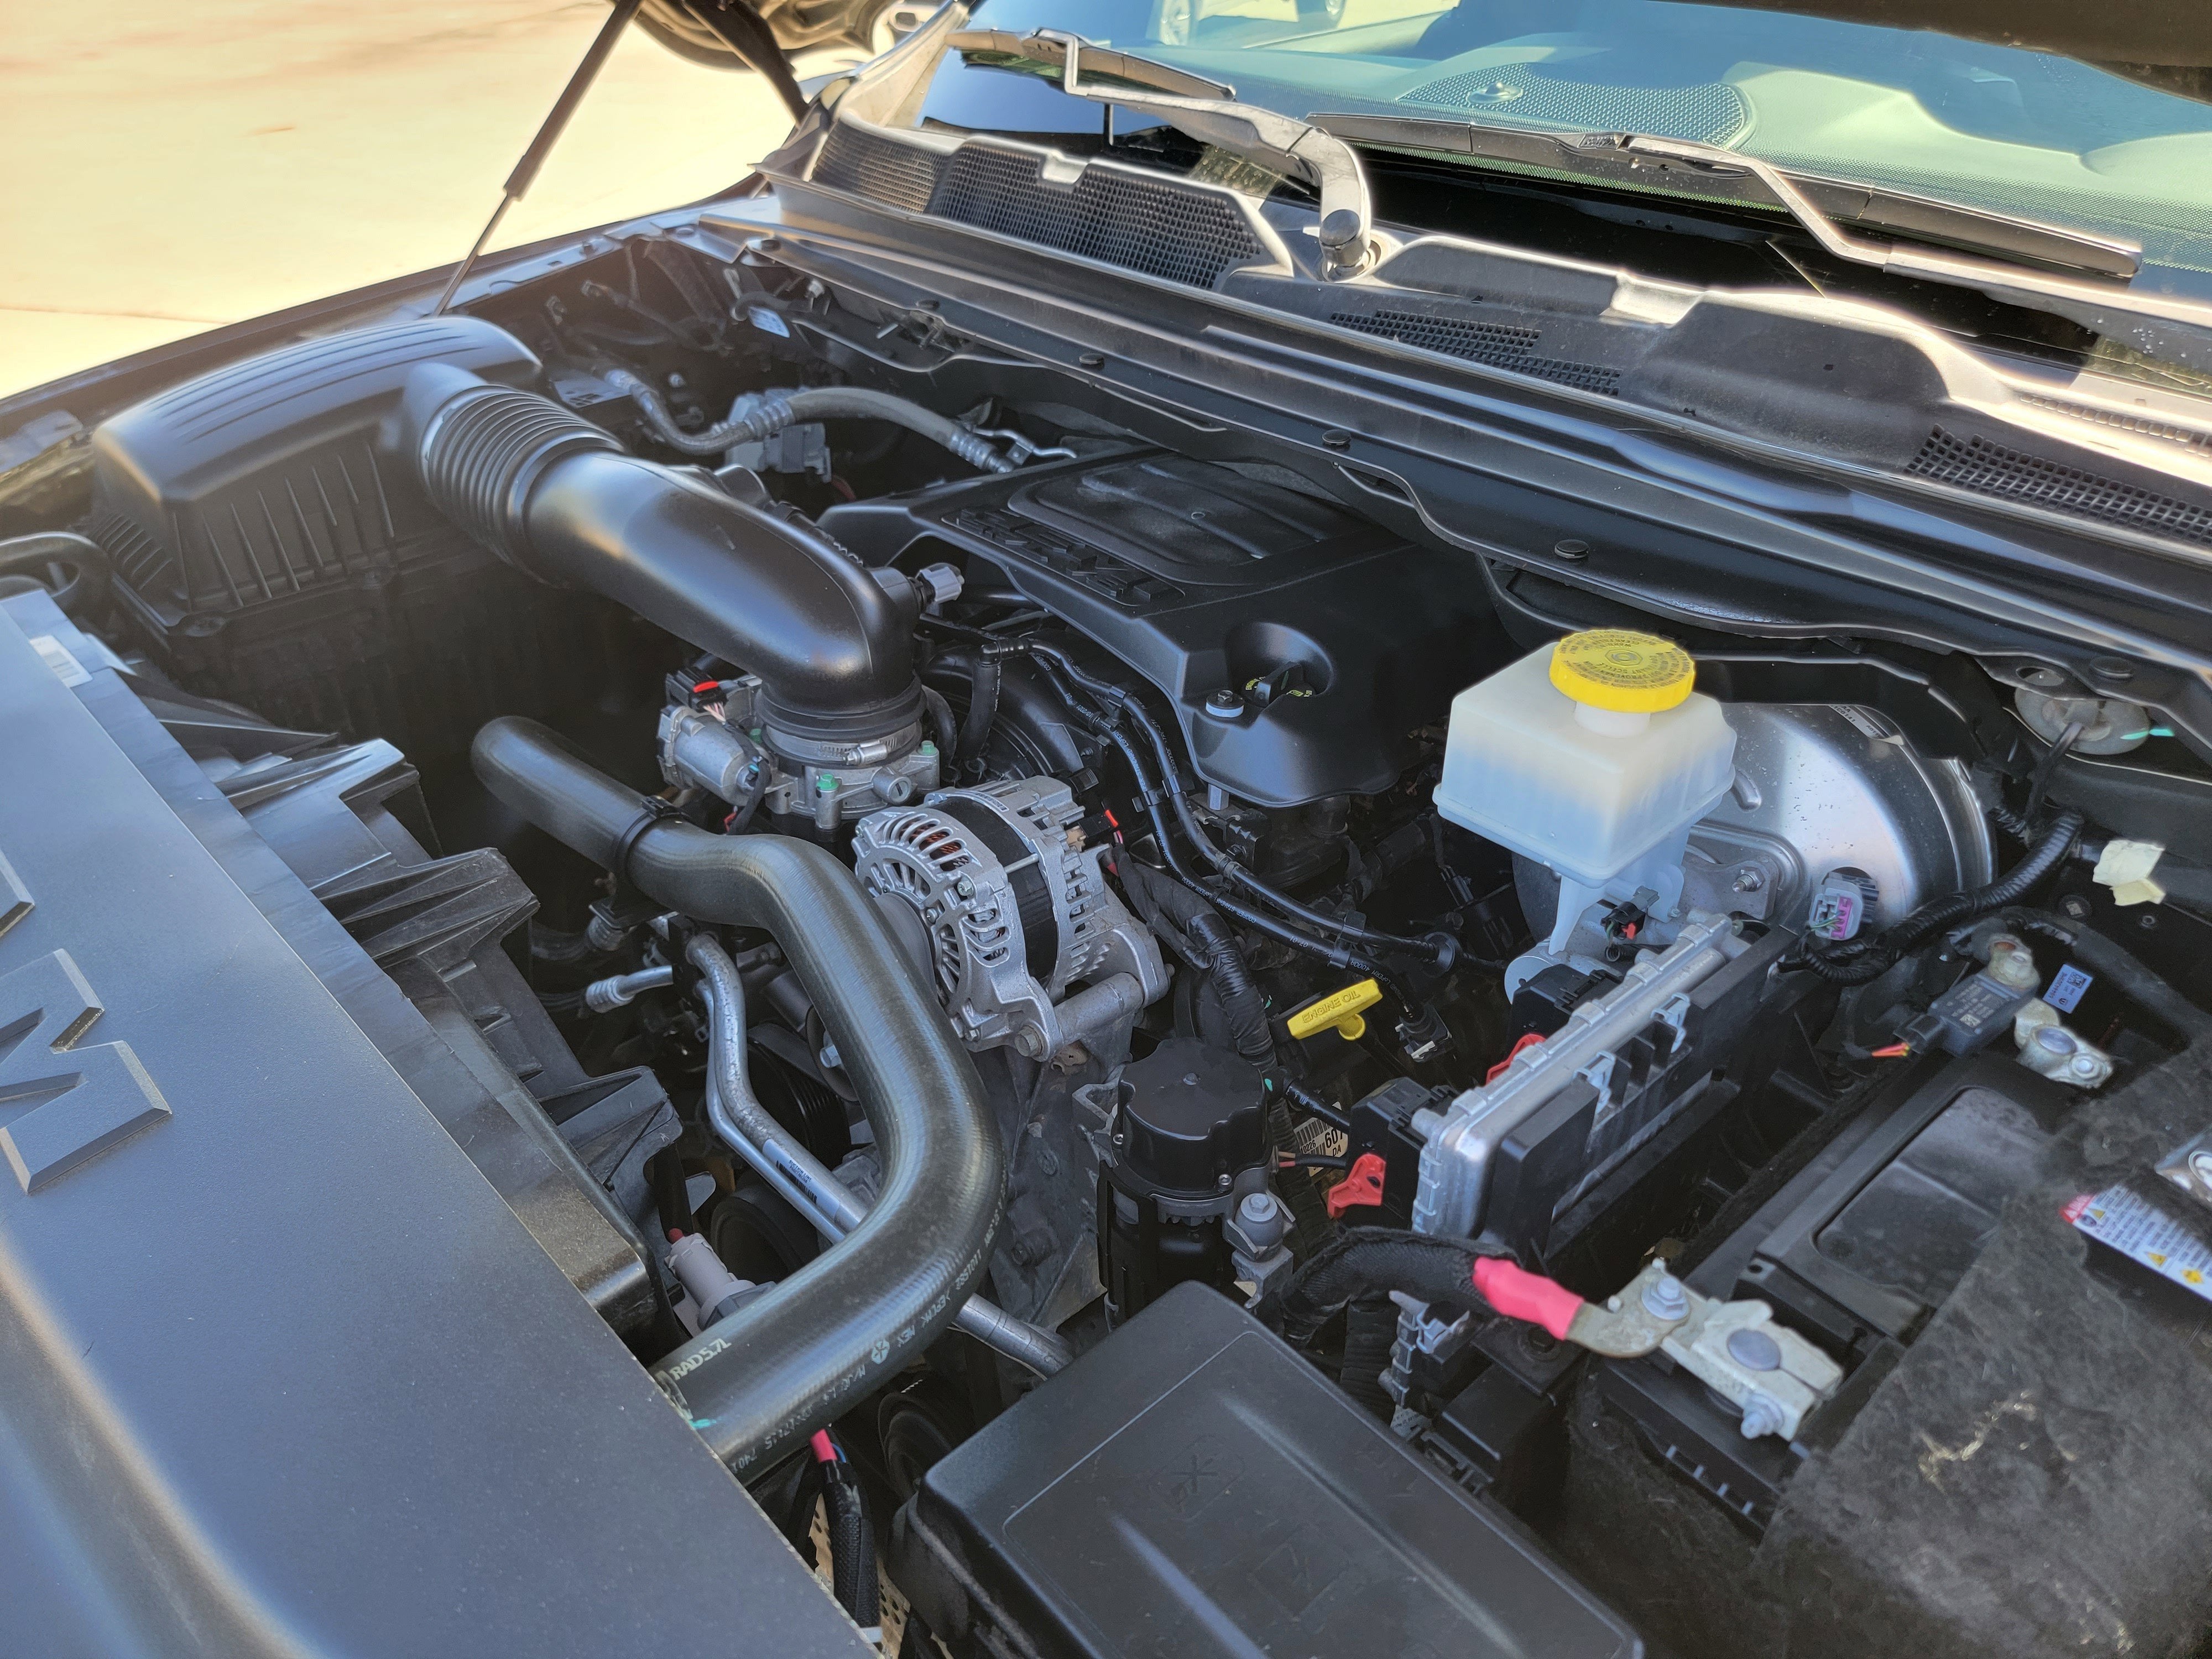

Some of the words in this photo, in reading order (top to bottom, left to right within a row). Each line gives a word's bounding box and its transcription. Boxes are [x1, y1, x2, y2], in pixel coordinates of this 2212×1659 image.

[1302, 998, 1342, 1024] ENGINE
[1342, 990, 1361, 1003] OIL
[1332, 1144, 1342, 1157] DA
